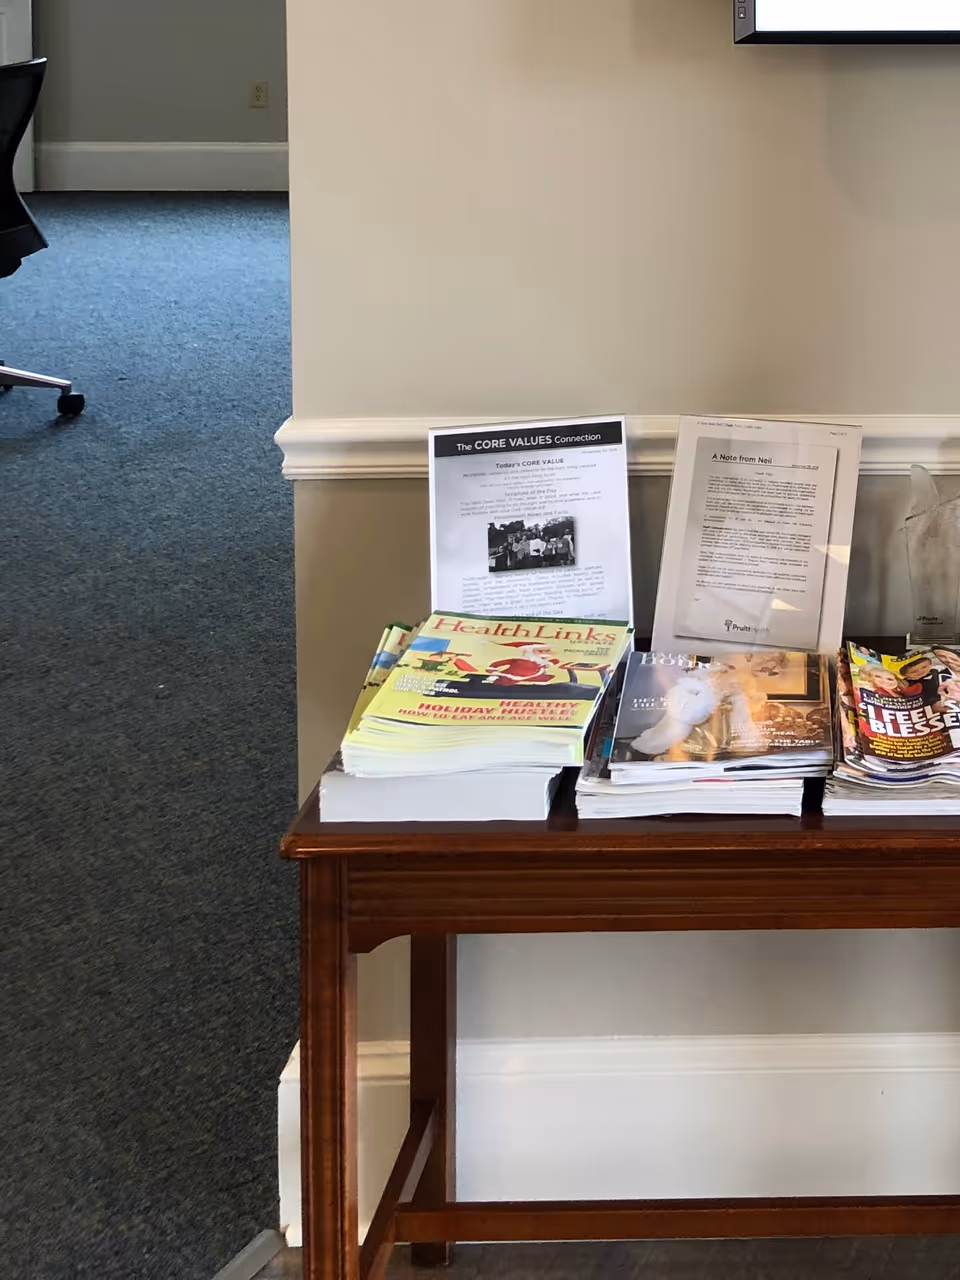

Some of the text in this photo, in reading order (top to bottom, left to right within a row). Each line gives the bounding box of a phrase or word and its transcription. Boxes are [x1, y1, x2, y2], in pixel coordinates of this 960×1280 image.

[456, 432, 601, 451] The CORE VALUES Connection
[495, 461, 521, 469] Today's
[542, 457, 565, 465] VALUE
[720, 453, 737, 461] Note
[739, 455, 756, 463] from
[757, 456, 773, 464] Neil
[433, 618, 617, 643] HealthLinks
[418, 703, 495, 714] HOLIDAY
[499, 700, 579, 708] HEALTHY
[398, 708, 429, 716] HOW
[881, 705, 940, 724] FEEL
